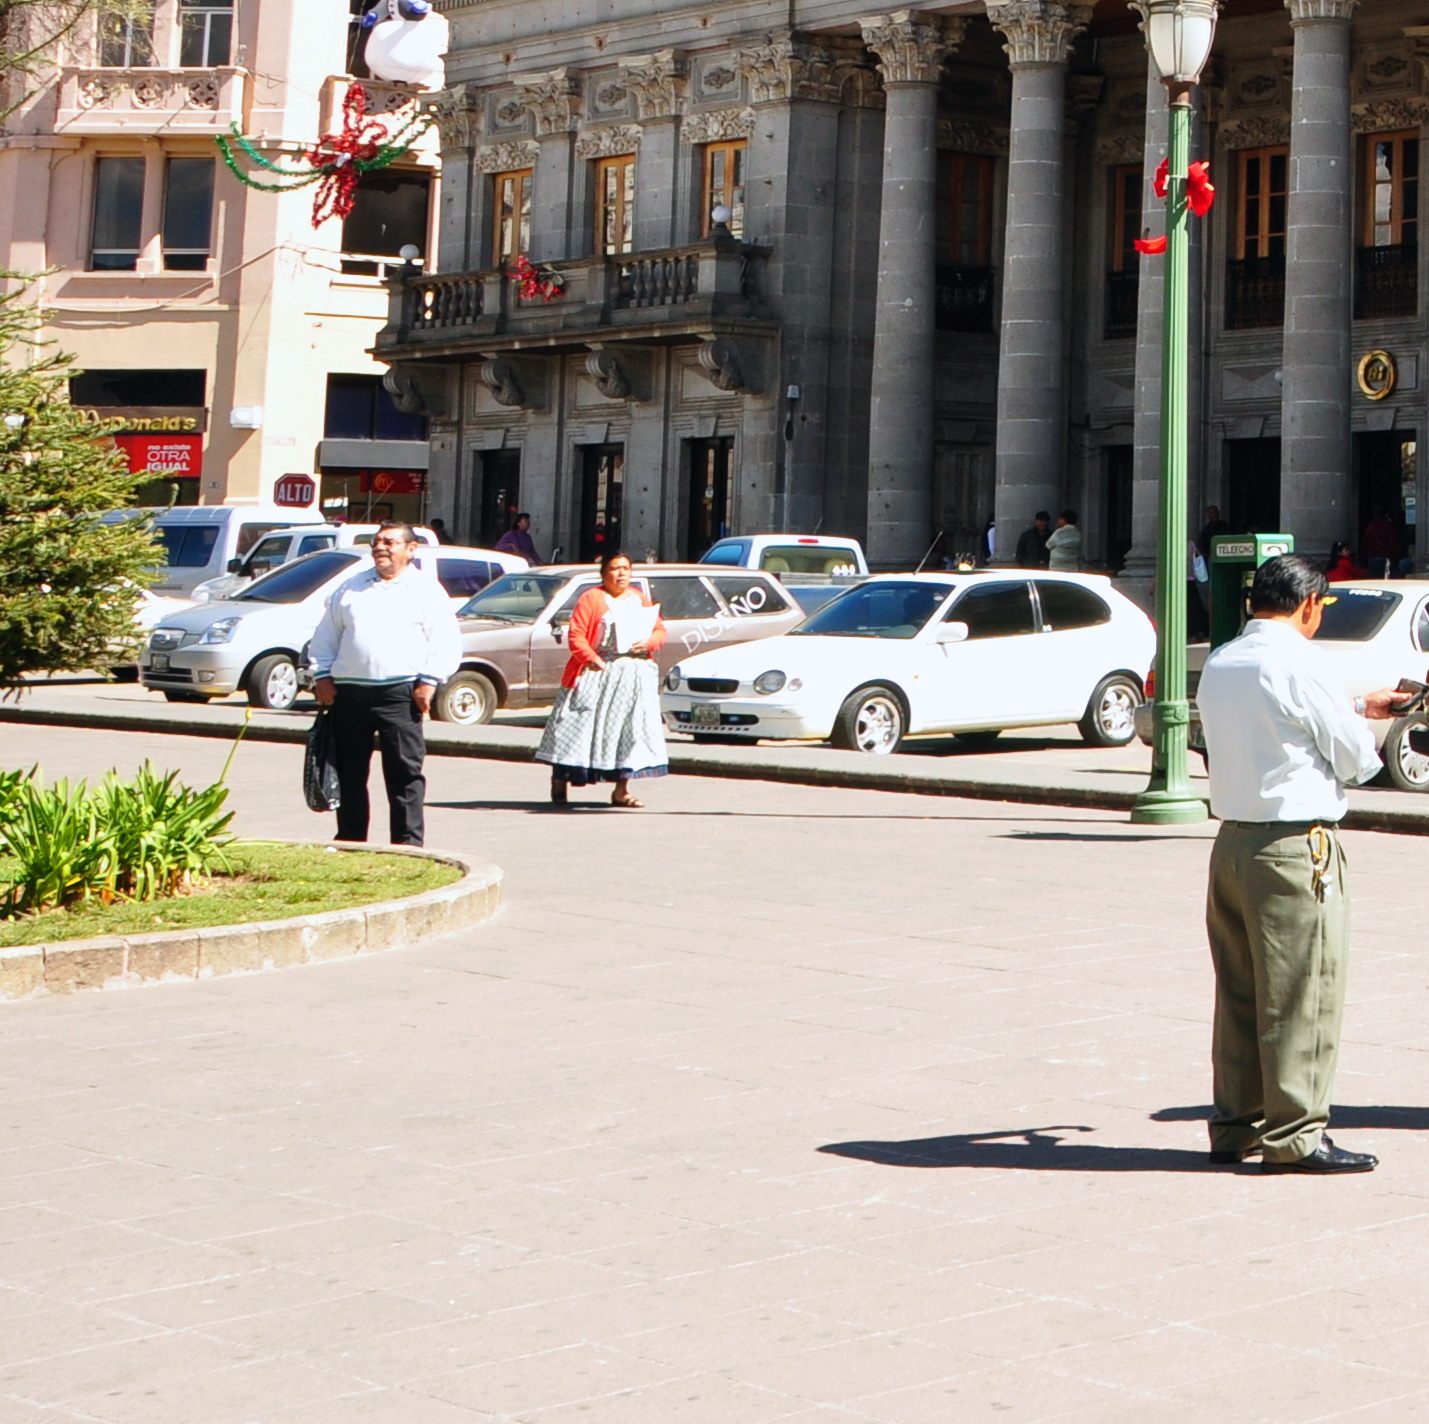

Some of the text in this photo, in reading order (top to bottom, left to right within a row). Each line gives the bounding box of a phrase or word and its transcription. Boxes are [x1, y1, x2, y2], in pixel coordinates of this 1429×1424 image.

[74, 409, 197, 431] McDonald's
[147, 450, 191, 461] OTRA
[146, 462, 190, 471] IGUAL
[277, 483, 311, 502] ALTO
[1218, 545, 1253, 554] TELEFONO
